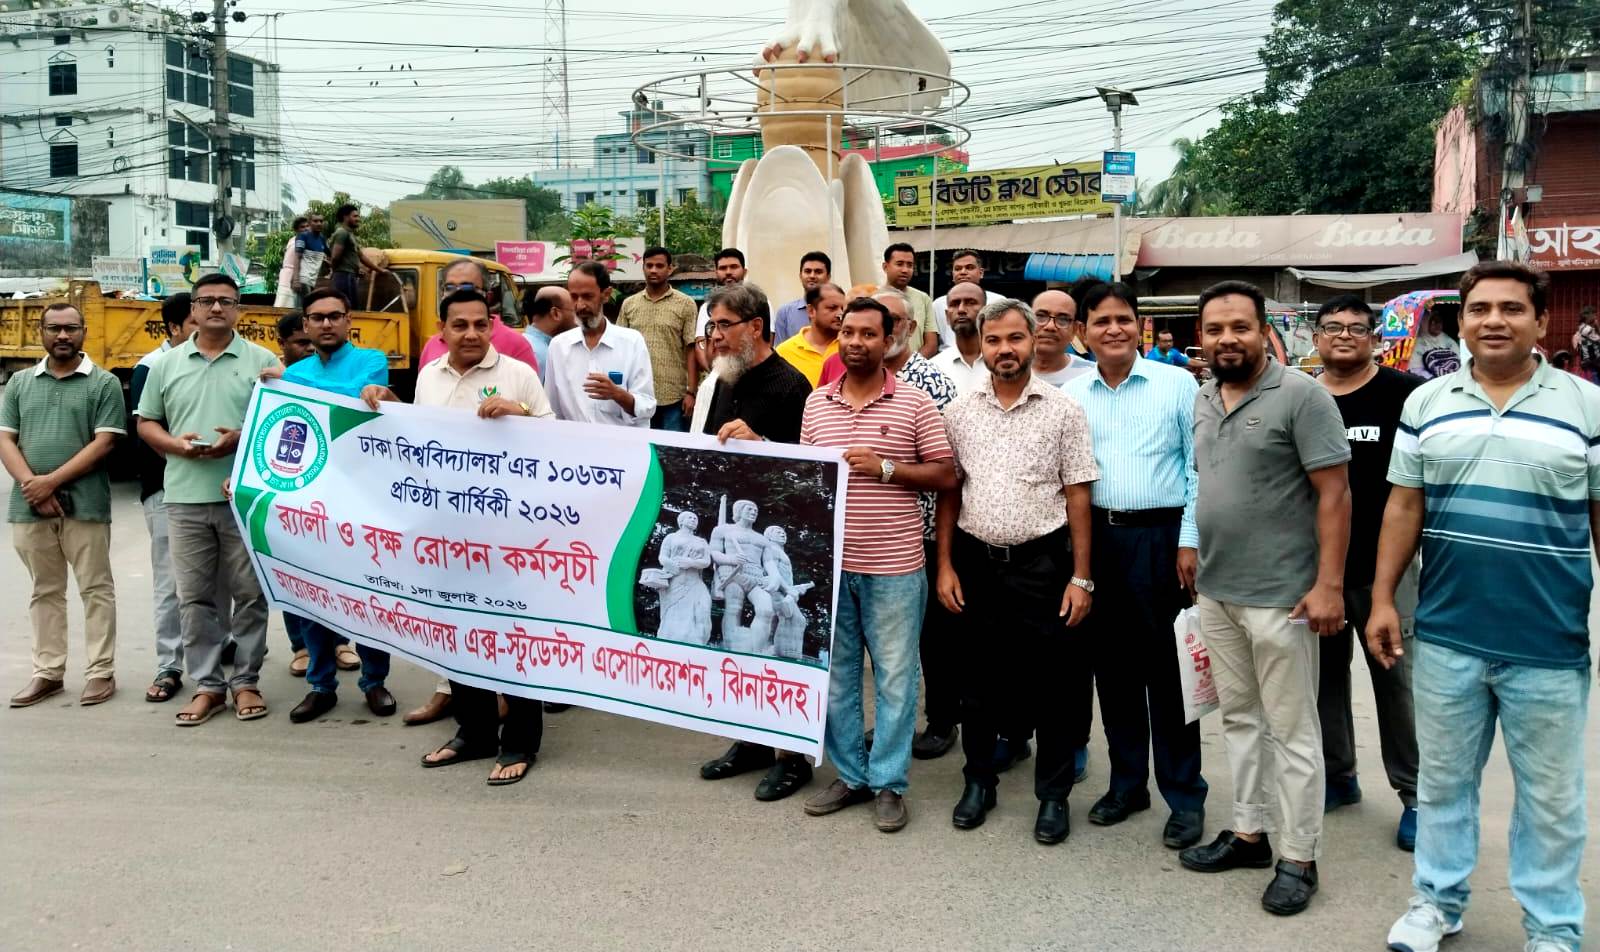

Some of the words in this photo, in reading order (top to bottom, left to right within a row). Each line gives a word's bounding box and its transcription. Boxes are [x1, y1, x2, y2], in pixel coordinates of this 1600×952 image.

[997, 177, 1040, 200] ক্লথ
[1150, 222, 1263, 249] Bata
[1314, 220, 1436, 248] Bata
[358, 435, 393, 461] ঢাকা
[547, 460, 626, 490] ১০৬তম
[391, 480, 440, 510] প্রতিষ্ঠা
[447, 487, 512, 518] বার্ষিকী
[518, 500, 580, 527] ২০২৬
[336, 520, 355, 548] ও
[362, 524, 404, 568] বৃক্ষ
[413, 536, 493, 575] রোপন
[498, 538, 600, 595] কর্মসূচী
[411, 585, 434, 599] ১লা
[436, 590, 478, 605] জুলাই
[484, 596, 528, 611] ২০২৬
[336, 593, 373, 628] ঢাকা
[369, 594, 458, 655] বিশ্ববিদ্যালয়
[592, 641, 713, 709] এসোসিয়েশন,
